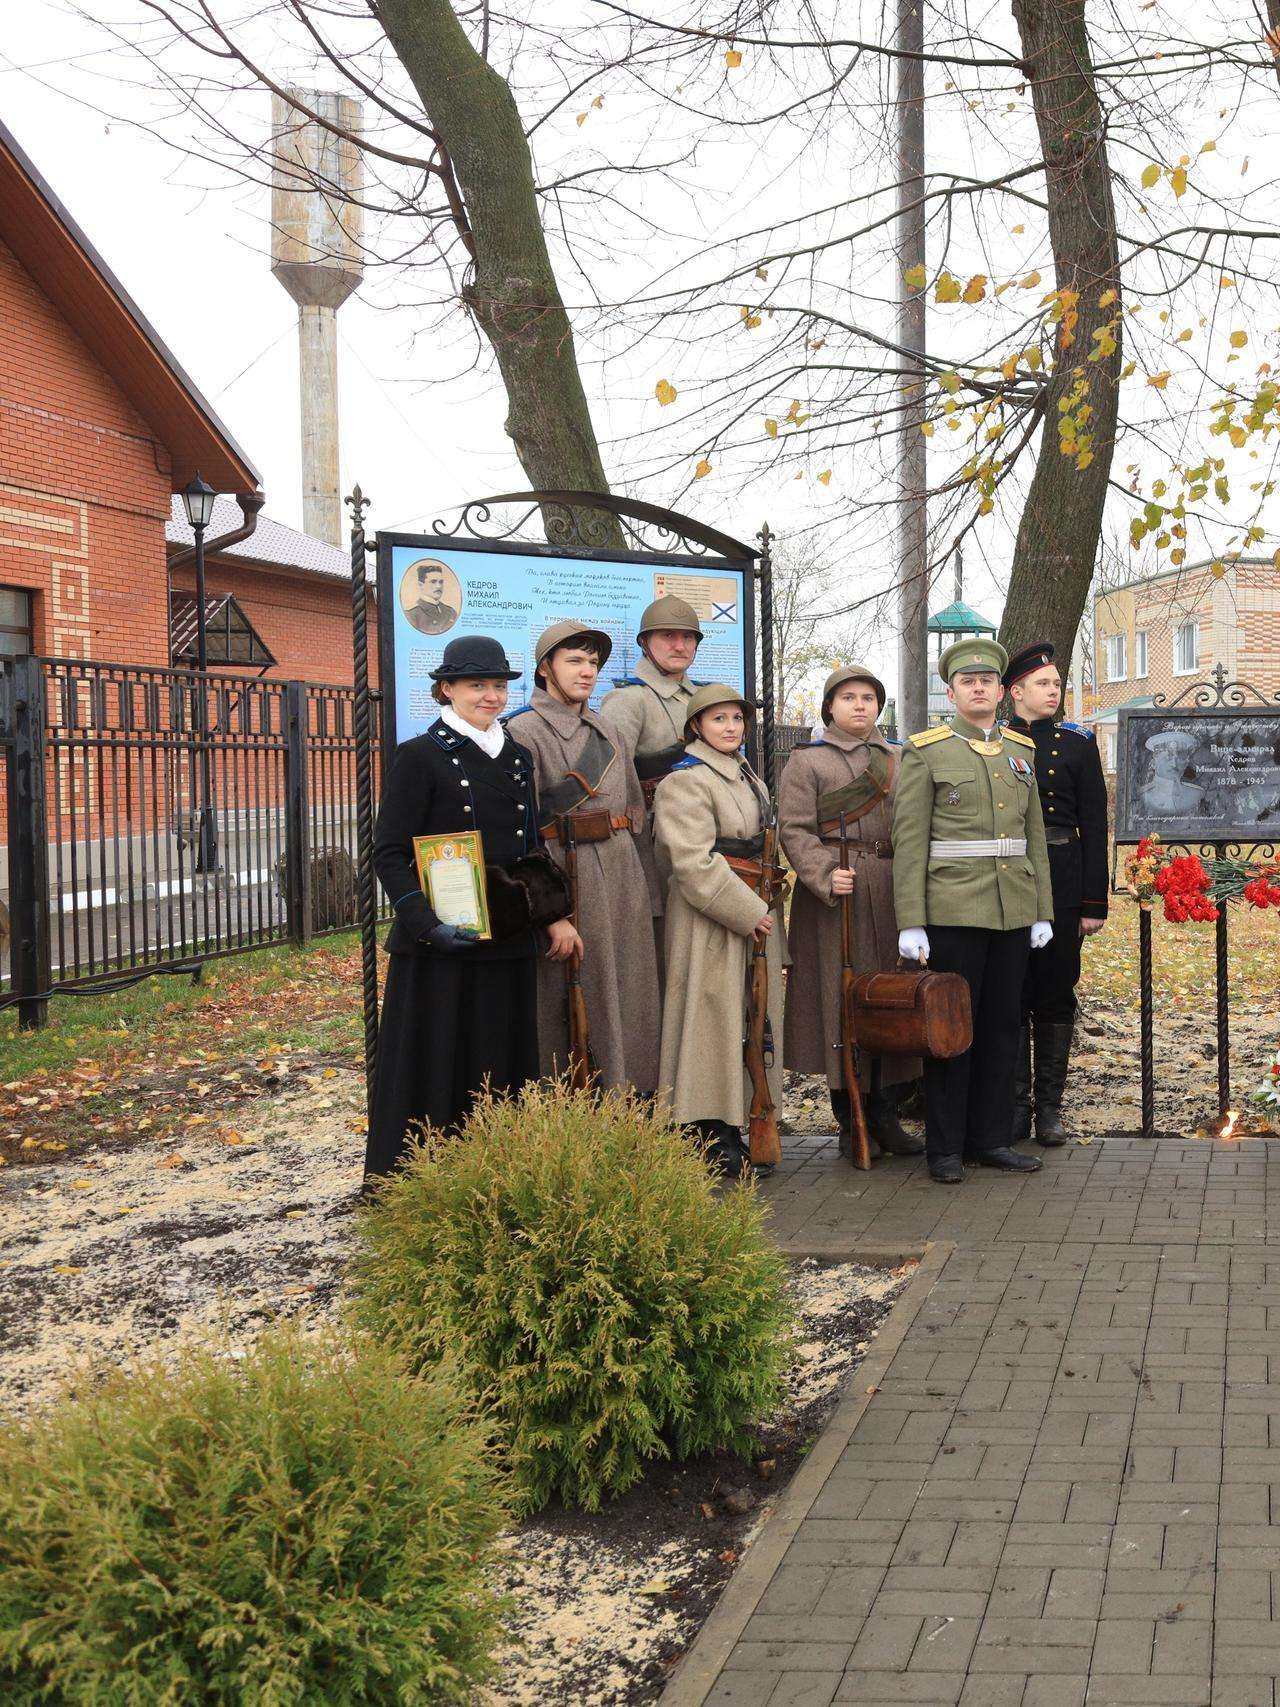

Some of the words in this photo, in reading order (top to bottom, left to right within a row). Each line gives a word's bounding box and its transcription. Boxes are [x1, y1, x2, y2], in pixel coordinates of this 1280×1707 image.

[467, 580, 498, 590] КЕДРОВ
[467, 590, 500, 600] МИХАИЛ
[467, 600, 533, 610] АЛЕКСАНДРОВИЧ
[1210, 744, 1275, 754] Вице-адмирал
[1228, 755, 1256, 763] Кедров
